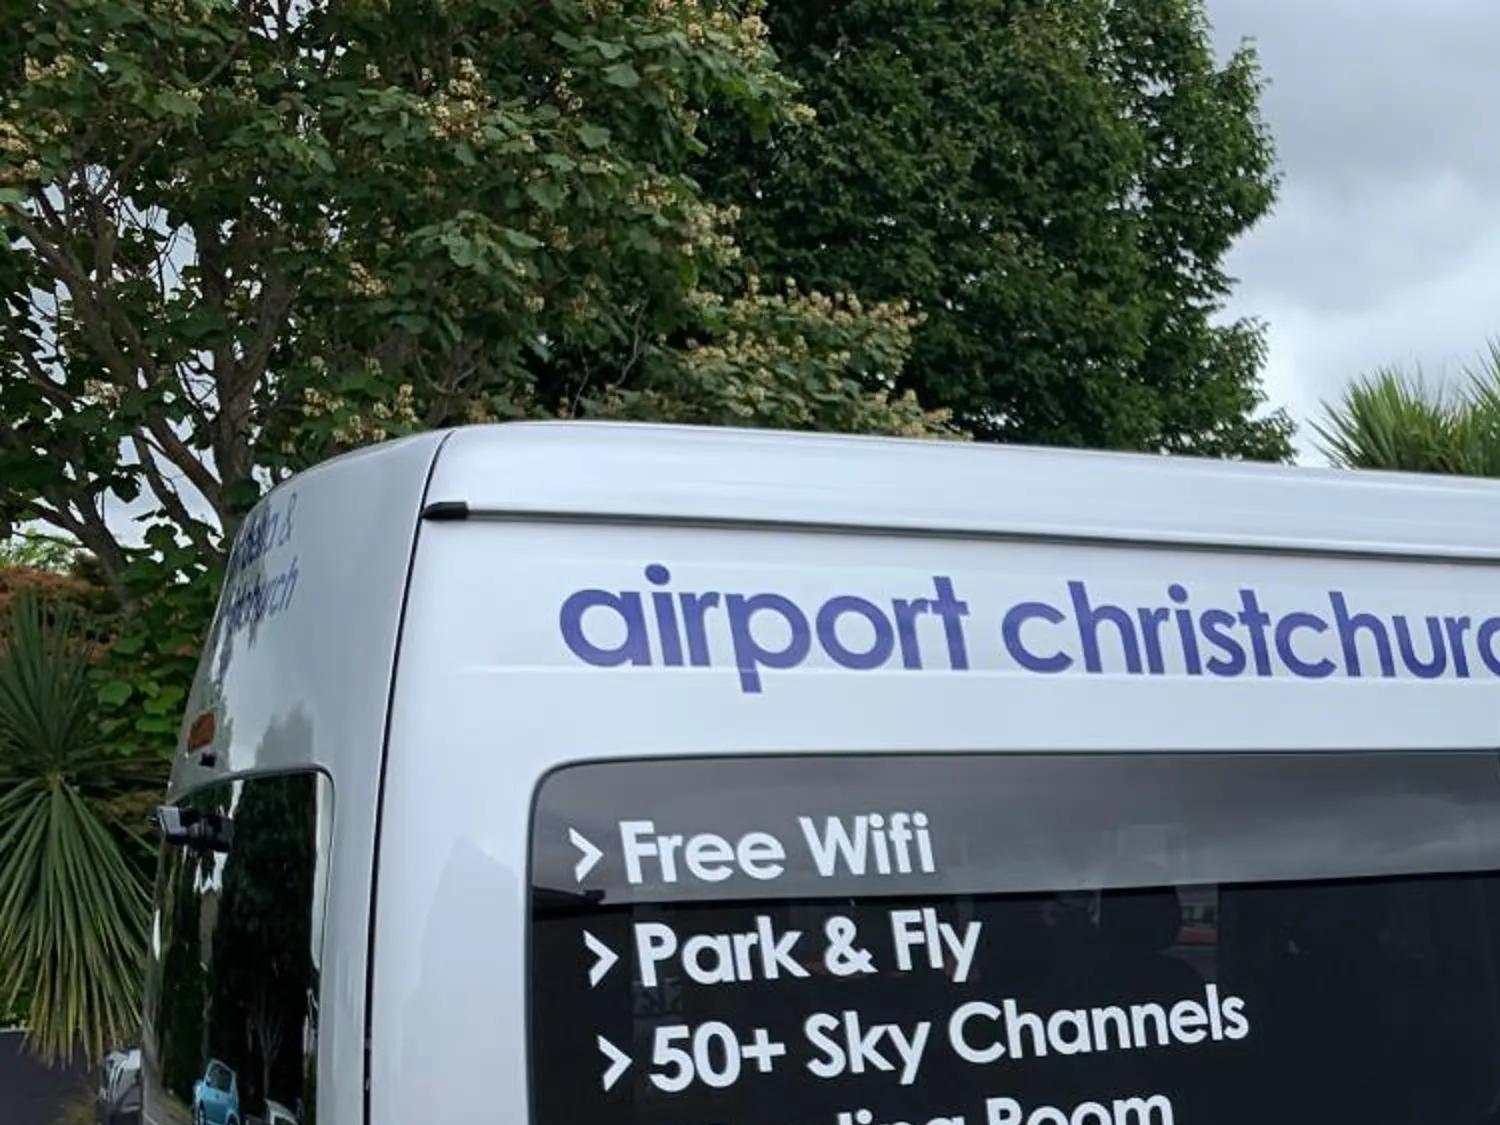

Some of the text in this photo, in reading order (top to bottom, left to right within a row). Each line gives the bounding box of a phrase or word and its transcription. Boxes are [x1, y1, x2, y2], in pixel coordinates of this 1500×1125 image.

[558, 562, 971, 694] airport
[618, 811, 936, 884] Free Wifi
[634, 907, 982, 987] Park & Fly
[650, 983, 1250, 1092] 50+ Sky Channels
